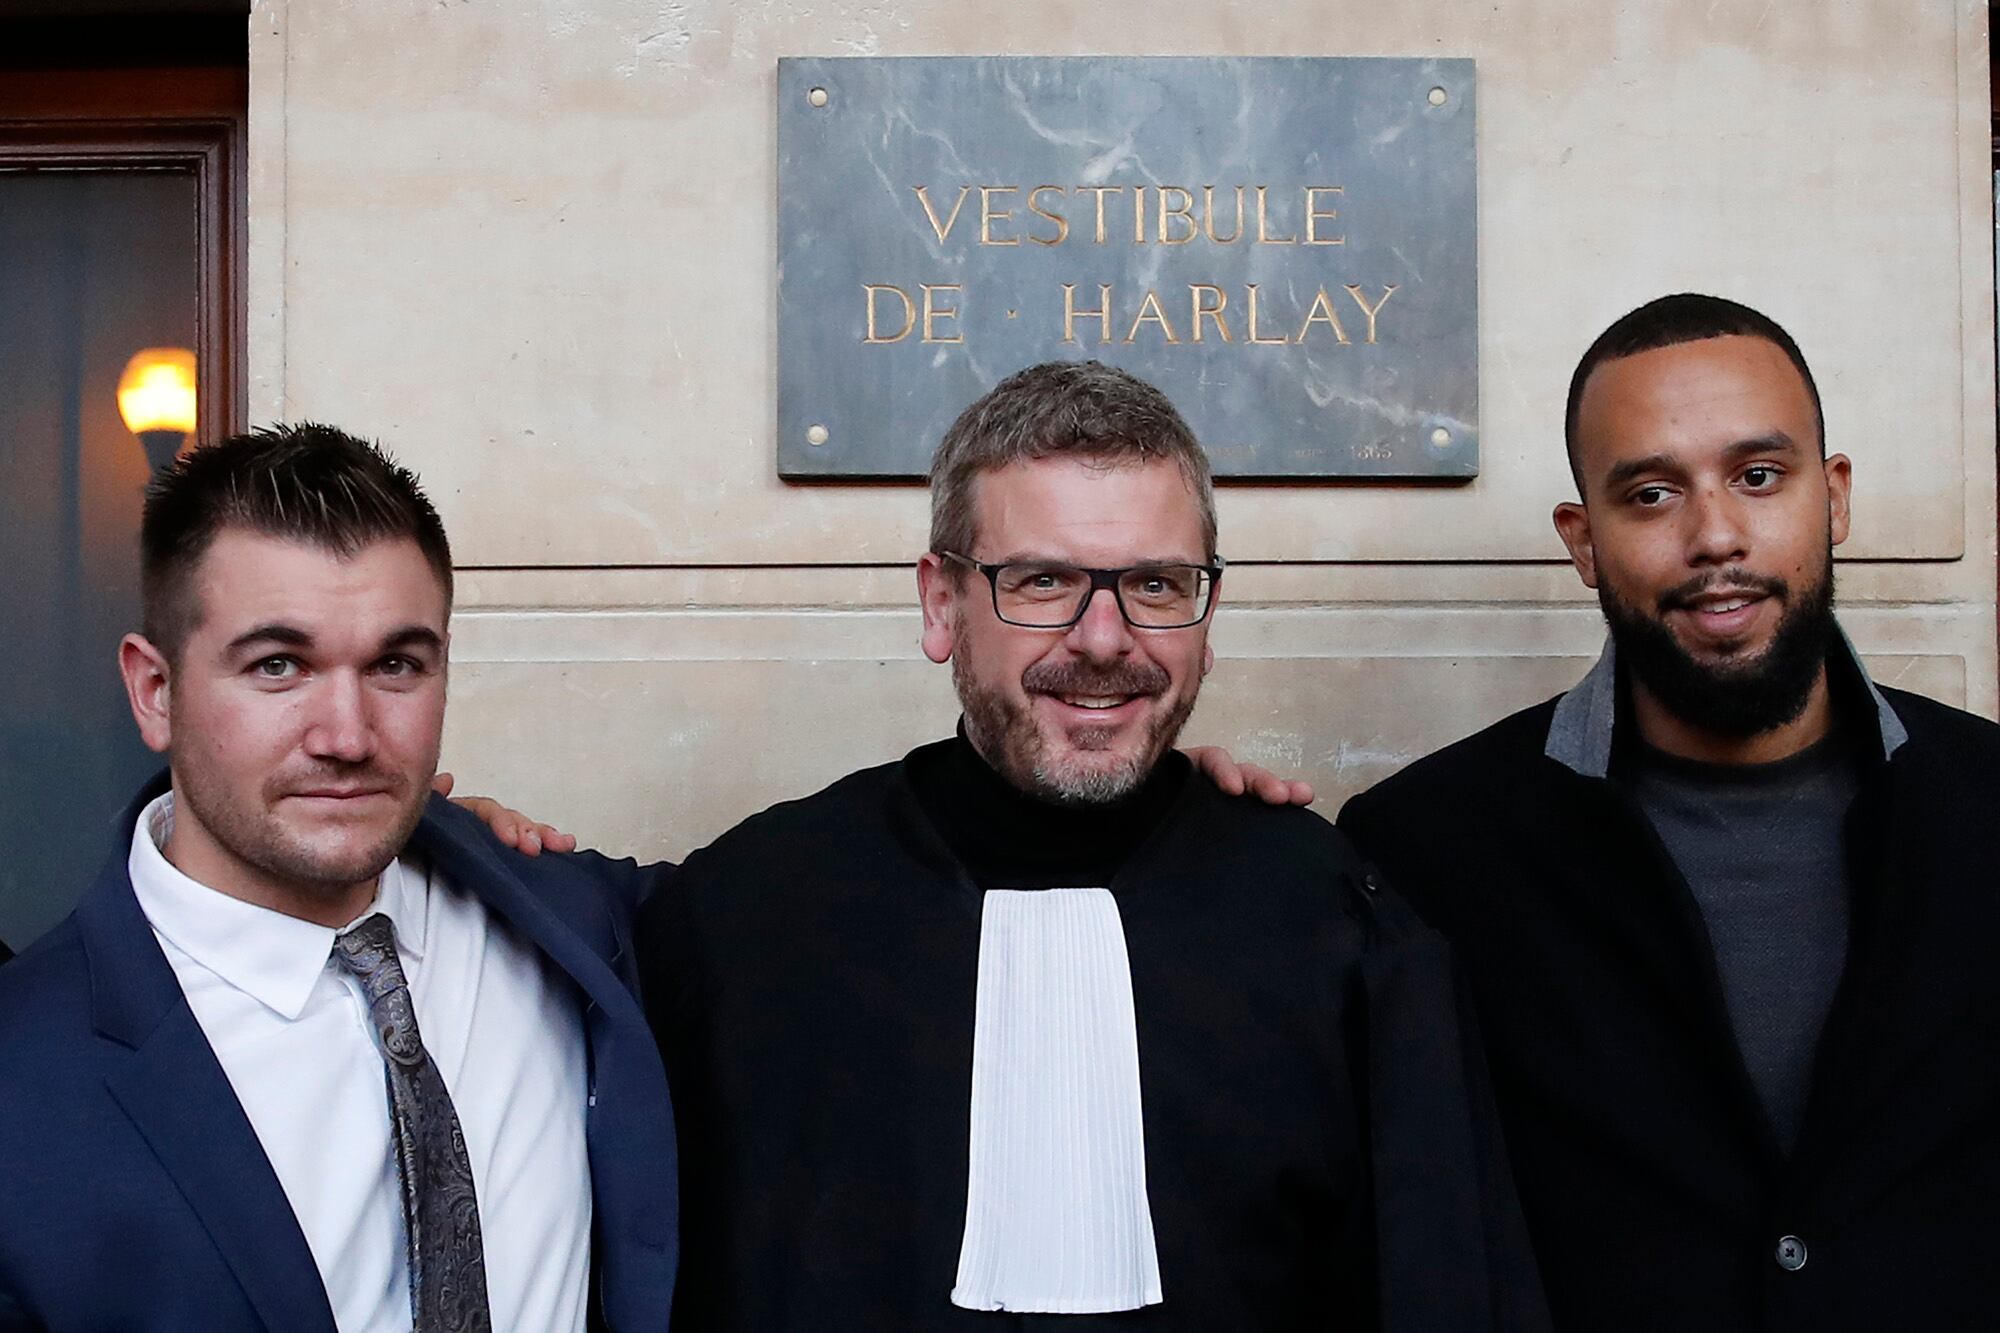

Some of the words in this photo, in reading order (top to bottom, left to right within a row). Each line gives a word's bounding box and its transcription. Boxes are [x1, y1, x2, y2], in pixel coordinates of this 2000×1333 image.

[912, 186, 1345, 246] VESTIBULE
[861, 283, 965, 345] DE
[1062, 283, 1400, 345] HARLAY
